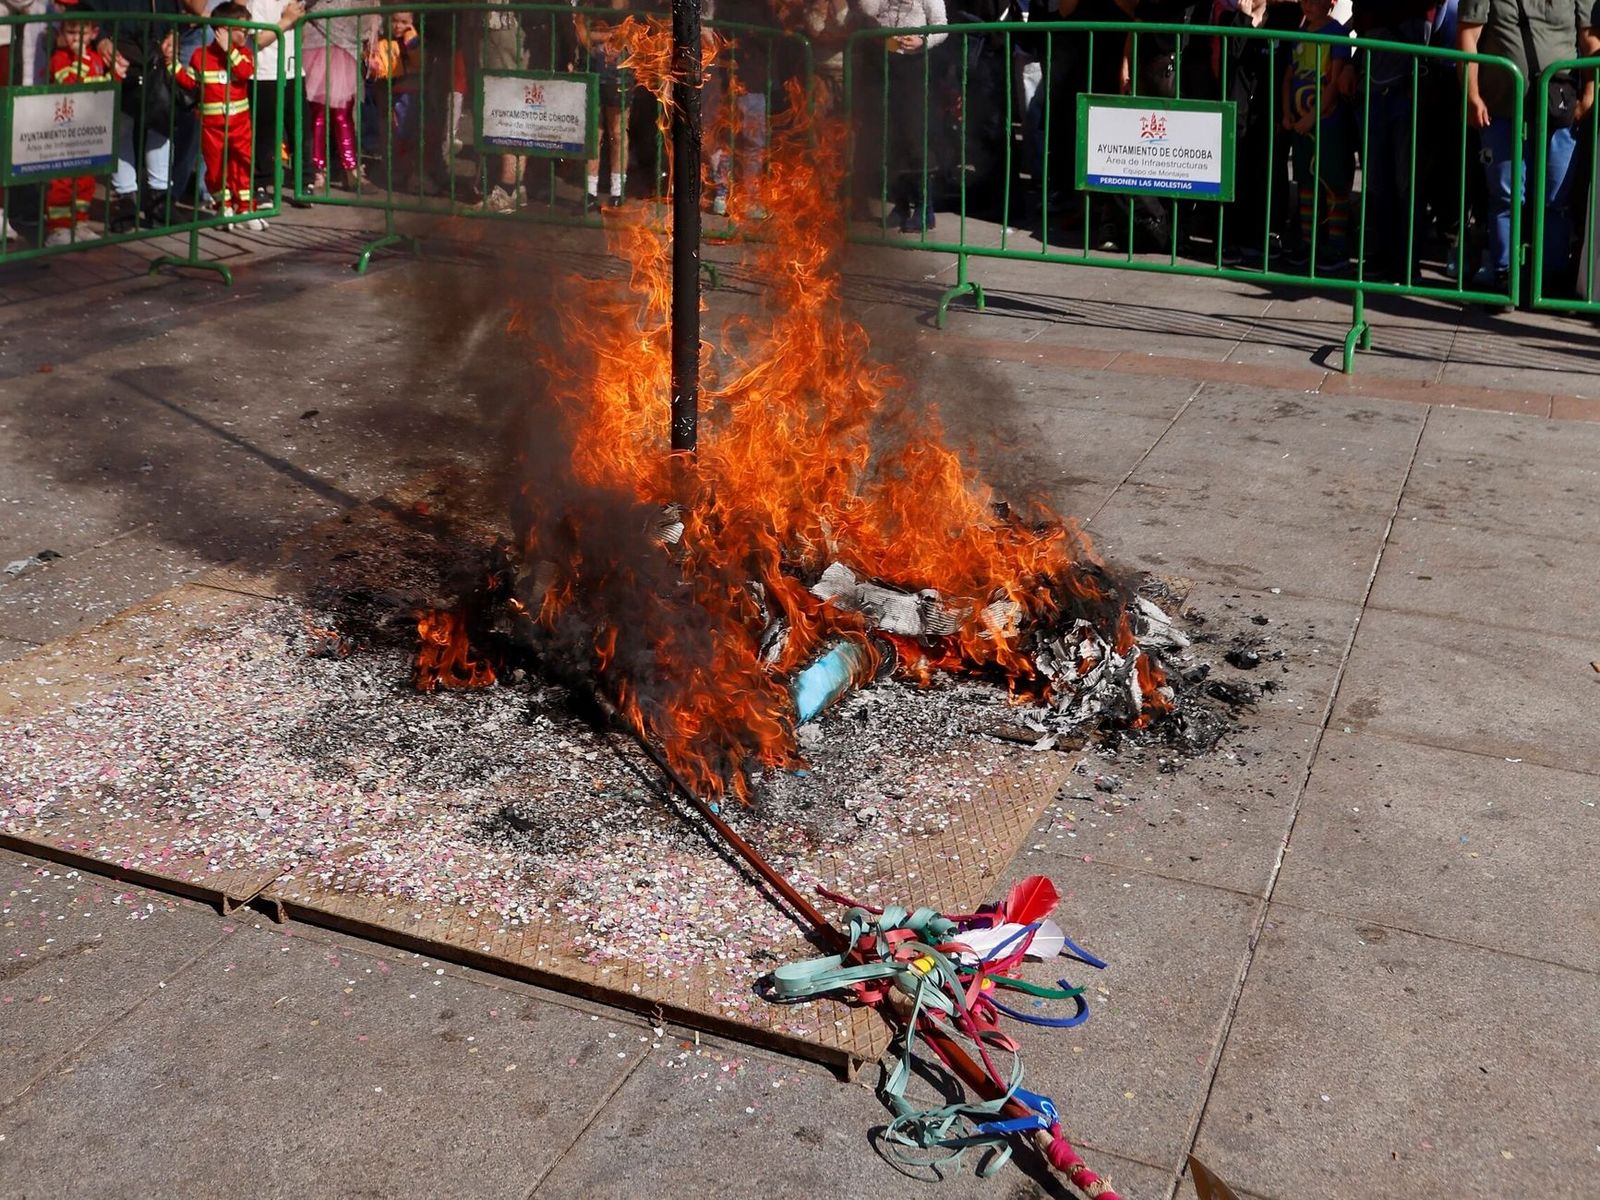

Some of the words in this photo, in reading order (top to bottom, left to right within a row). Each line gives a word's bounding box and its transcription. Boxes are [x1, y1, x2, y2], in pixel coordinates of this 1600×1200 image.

[1097, 144, 1158, 157] AYUNTAMIENTO
[1159, 147, 1170, 157] DE
[1172, 146, 1213, 159] CÓRDOBA
[1128, 158, 1139, 166] de
[1141, 158, 1208, 170] Infraestructuras
[1100, 177, 1137, 186] PERDONEN
[1153, 181, 1192, 190] MOLESTIAS
